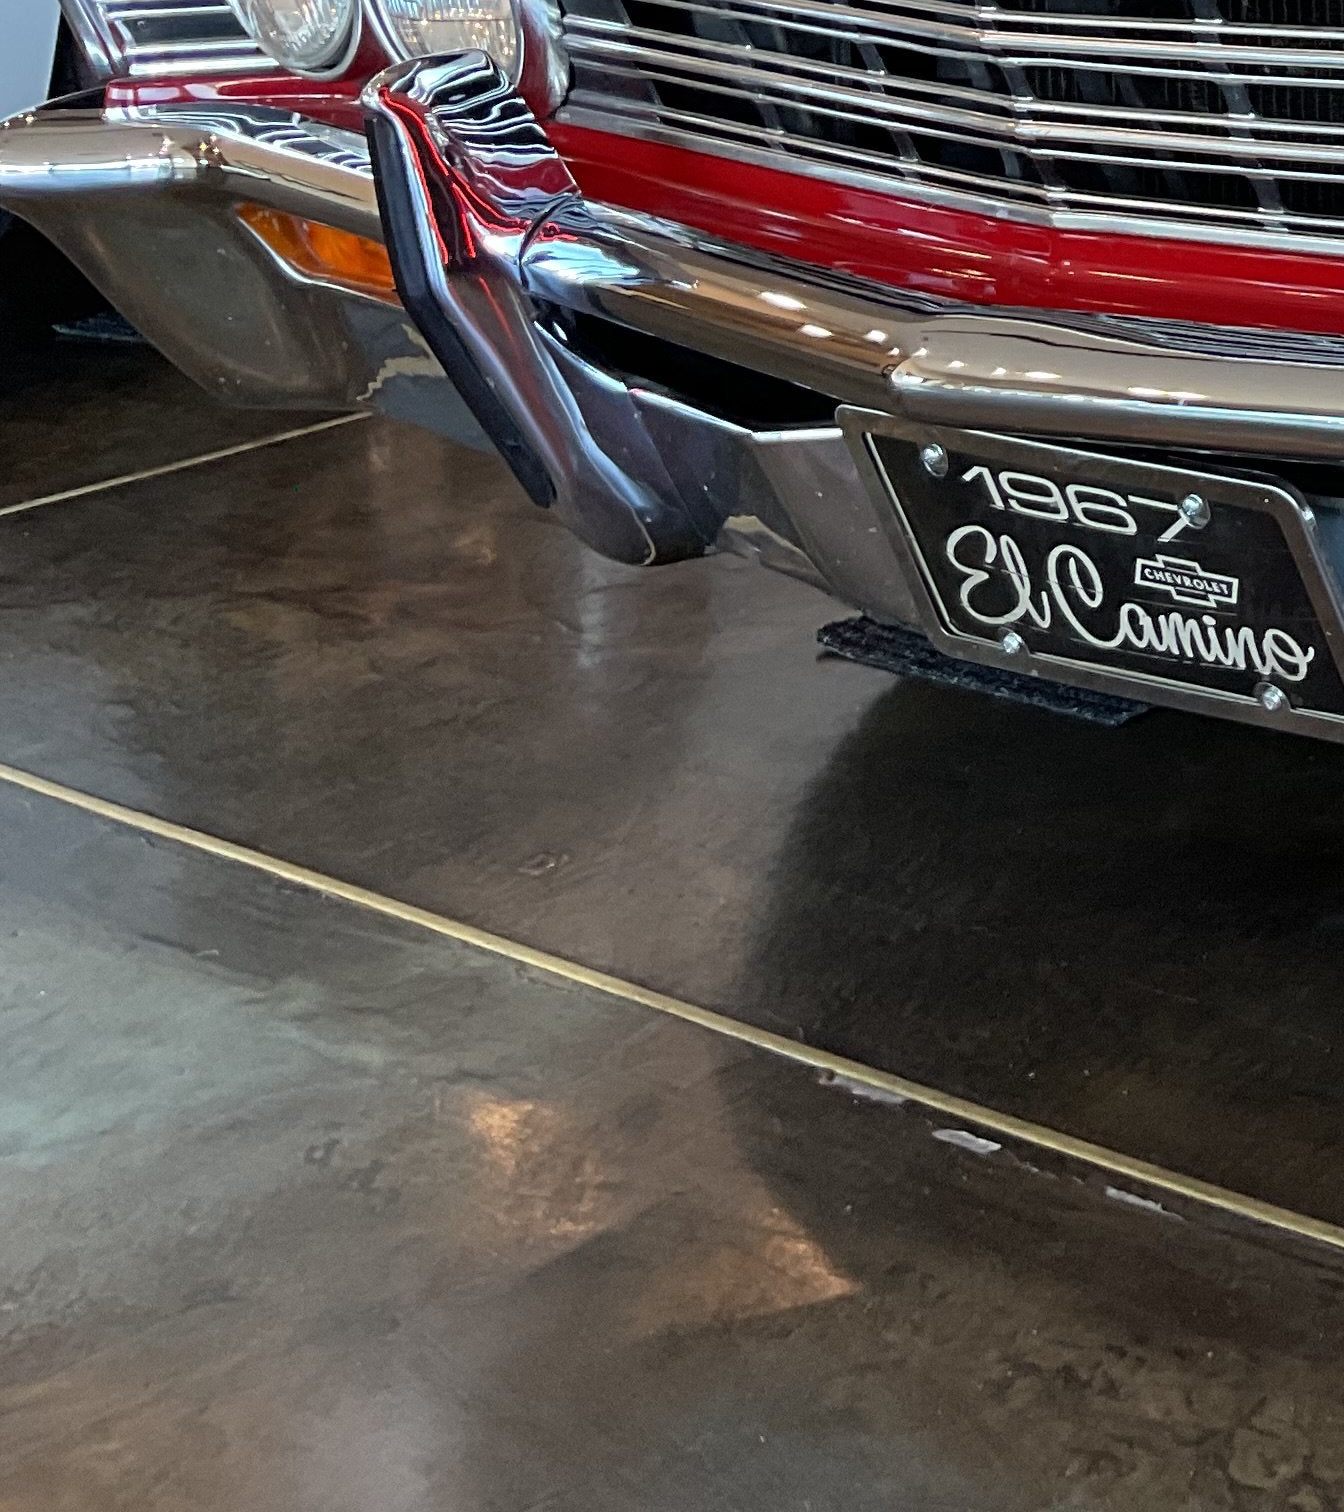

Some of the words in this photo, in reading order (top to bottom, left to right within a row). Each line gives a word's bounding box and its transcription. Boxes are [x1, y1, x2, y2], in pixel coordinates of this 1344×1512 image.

[962, 465, 1194, 543] 1967
[945, 524, 1051, 629] El
[1046, 543, 1315, 682] Camino
[1143, 567, 1230, 596] CHEVROLET
